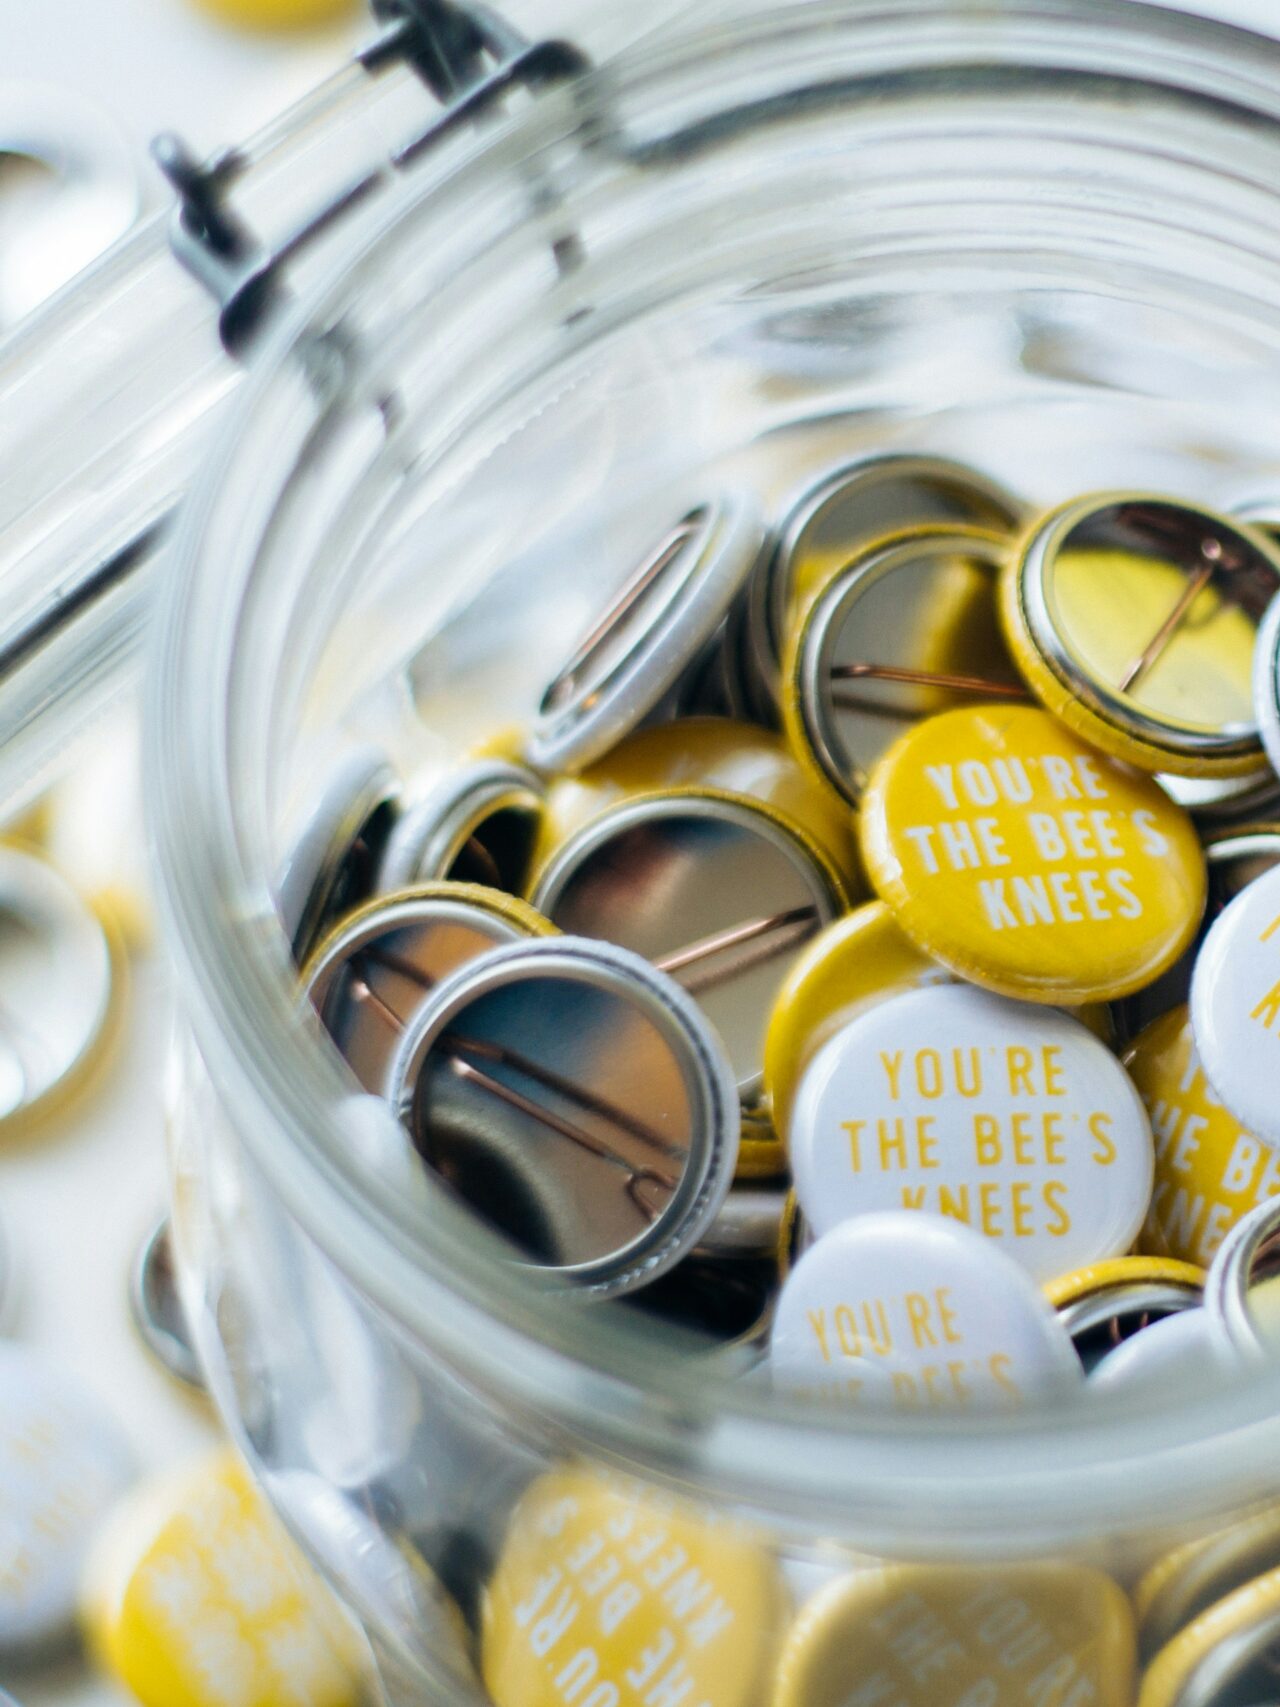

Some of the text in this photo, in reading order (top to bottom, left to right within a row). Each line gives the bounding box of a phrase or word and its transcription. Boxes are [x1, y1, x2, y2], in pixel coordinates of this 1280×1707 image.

[924, 754, 1109, 810] YOU'RE
[903, 808, 1170, 874] THE BEE'S
[977, 867, 1145, 931] KNEES
[879, 1045, 1067, 1100] YOU'RE
[840, 1112, 1118, 1173] THE BEE'S
[1150, 1100, 1209, 1174] HE
[806, 1286, 965, 1364] YOU'RE
